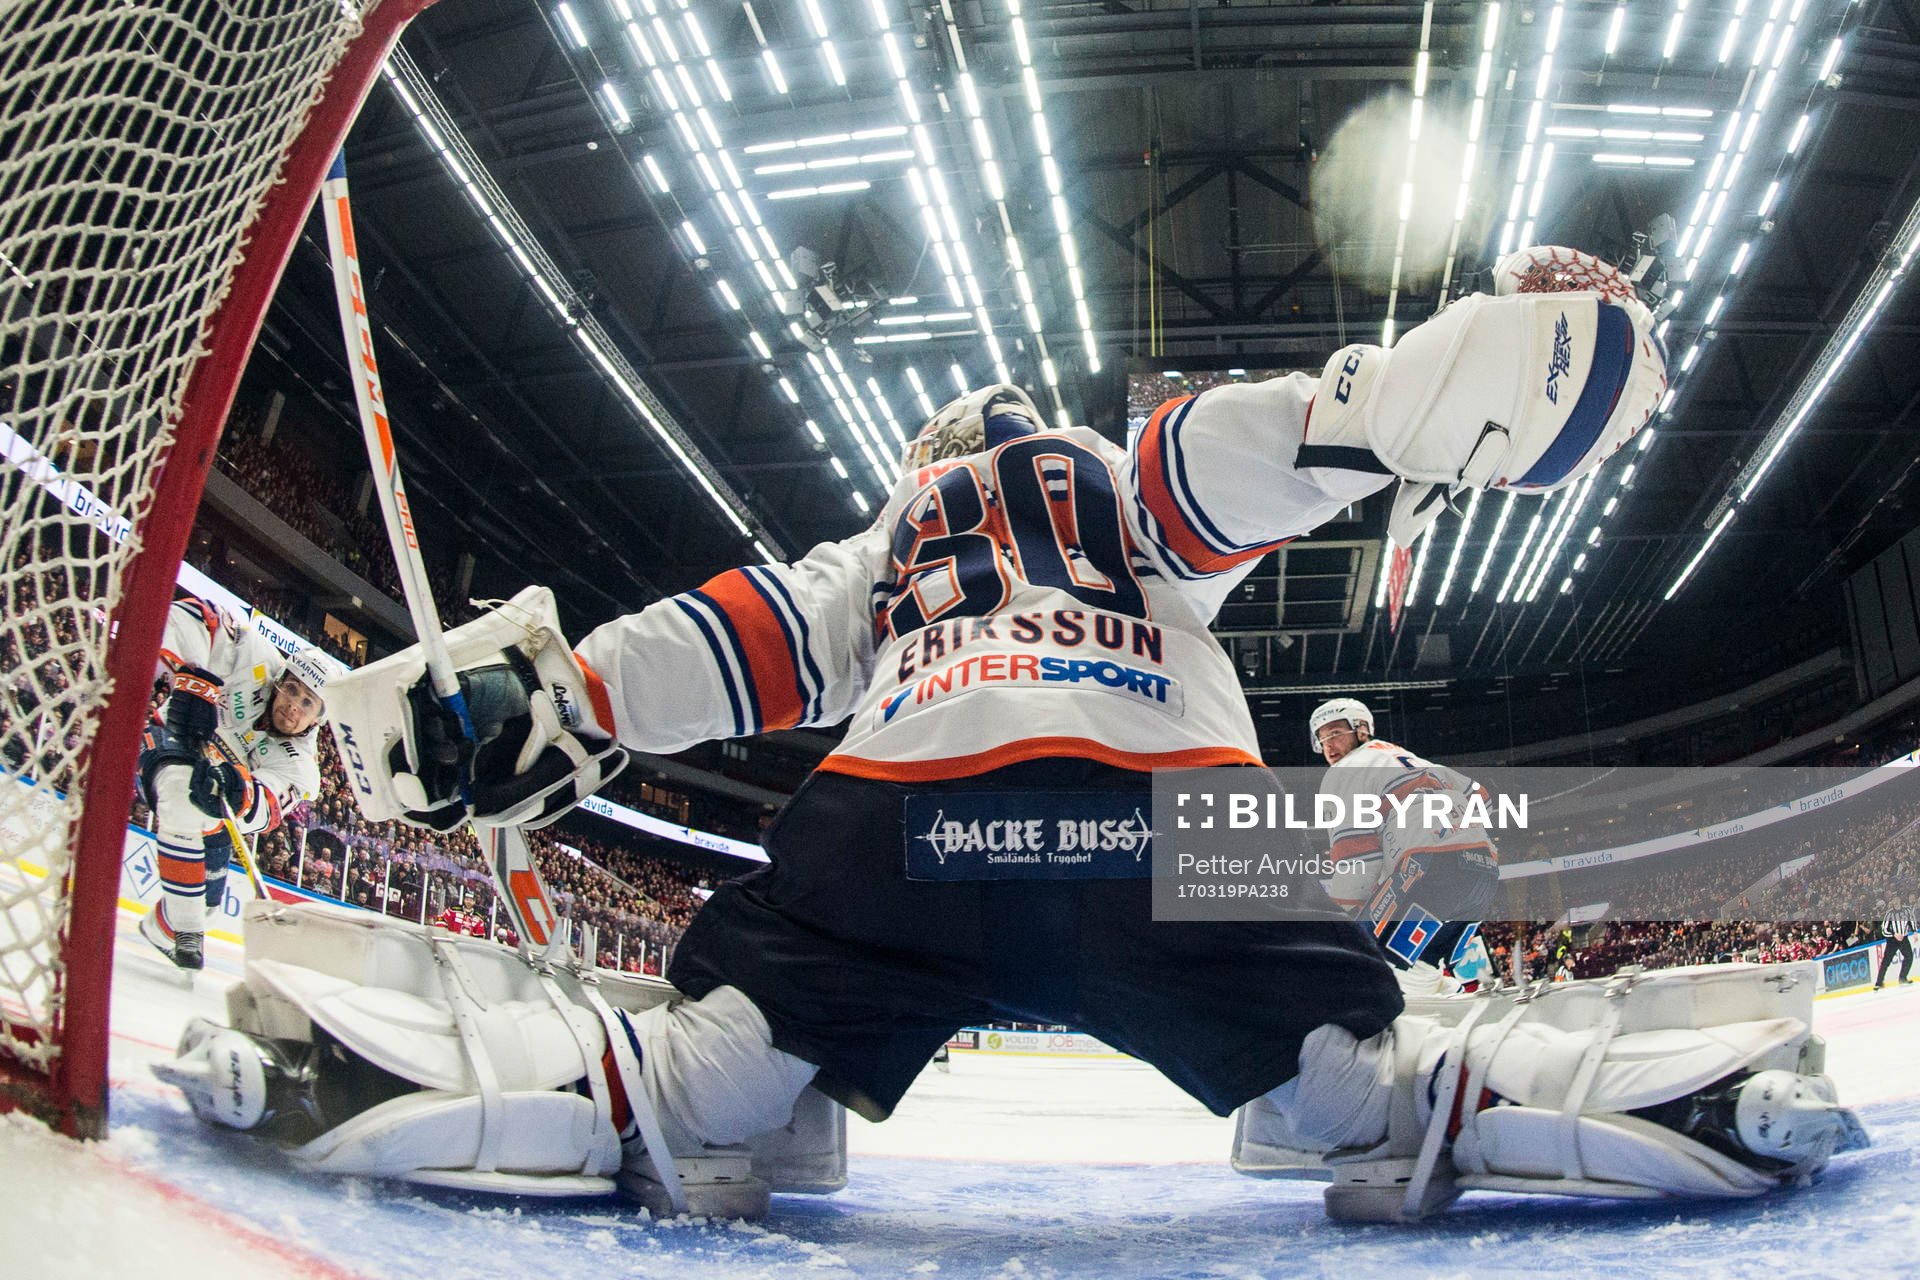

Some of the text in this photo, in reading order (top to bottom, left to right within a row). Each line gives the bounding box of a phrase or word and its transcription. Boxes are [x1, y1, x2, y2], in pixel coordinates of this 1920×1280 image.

[898, 609, 1165, 684] ERIKSSON
[915, 654, 1172, 705] INTERSPORT
[339, 722, 373, 796] CCM
[1799, 787, 1845, 812] bravida
[1056, 818, 1138, 852] BUSS
[1706, 823, 1745, 840] bravida
[987, 852, 1042, 864] Småländsk
[1562, 851, 1614, 869] bravida
[1372, 892, 1394, 921] ALWEX
[1825, 956, 1869, 985] areco
